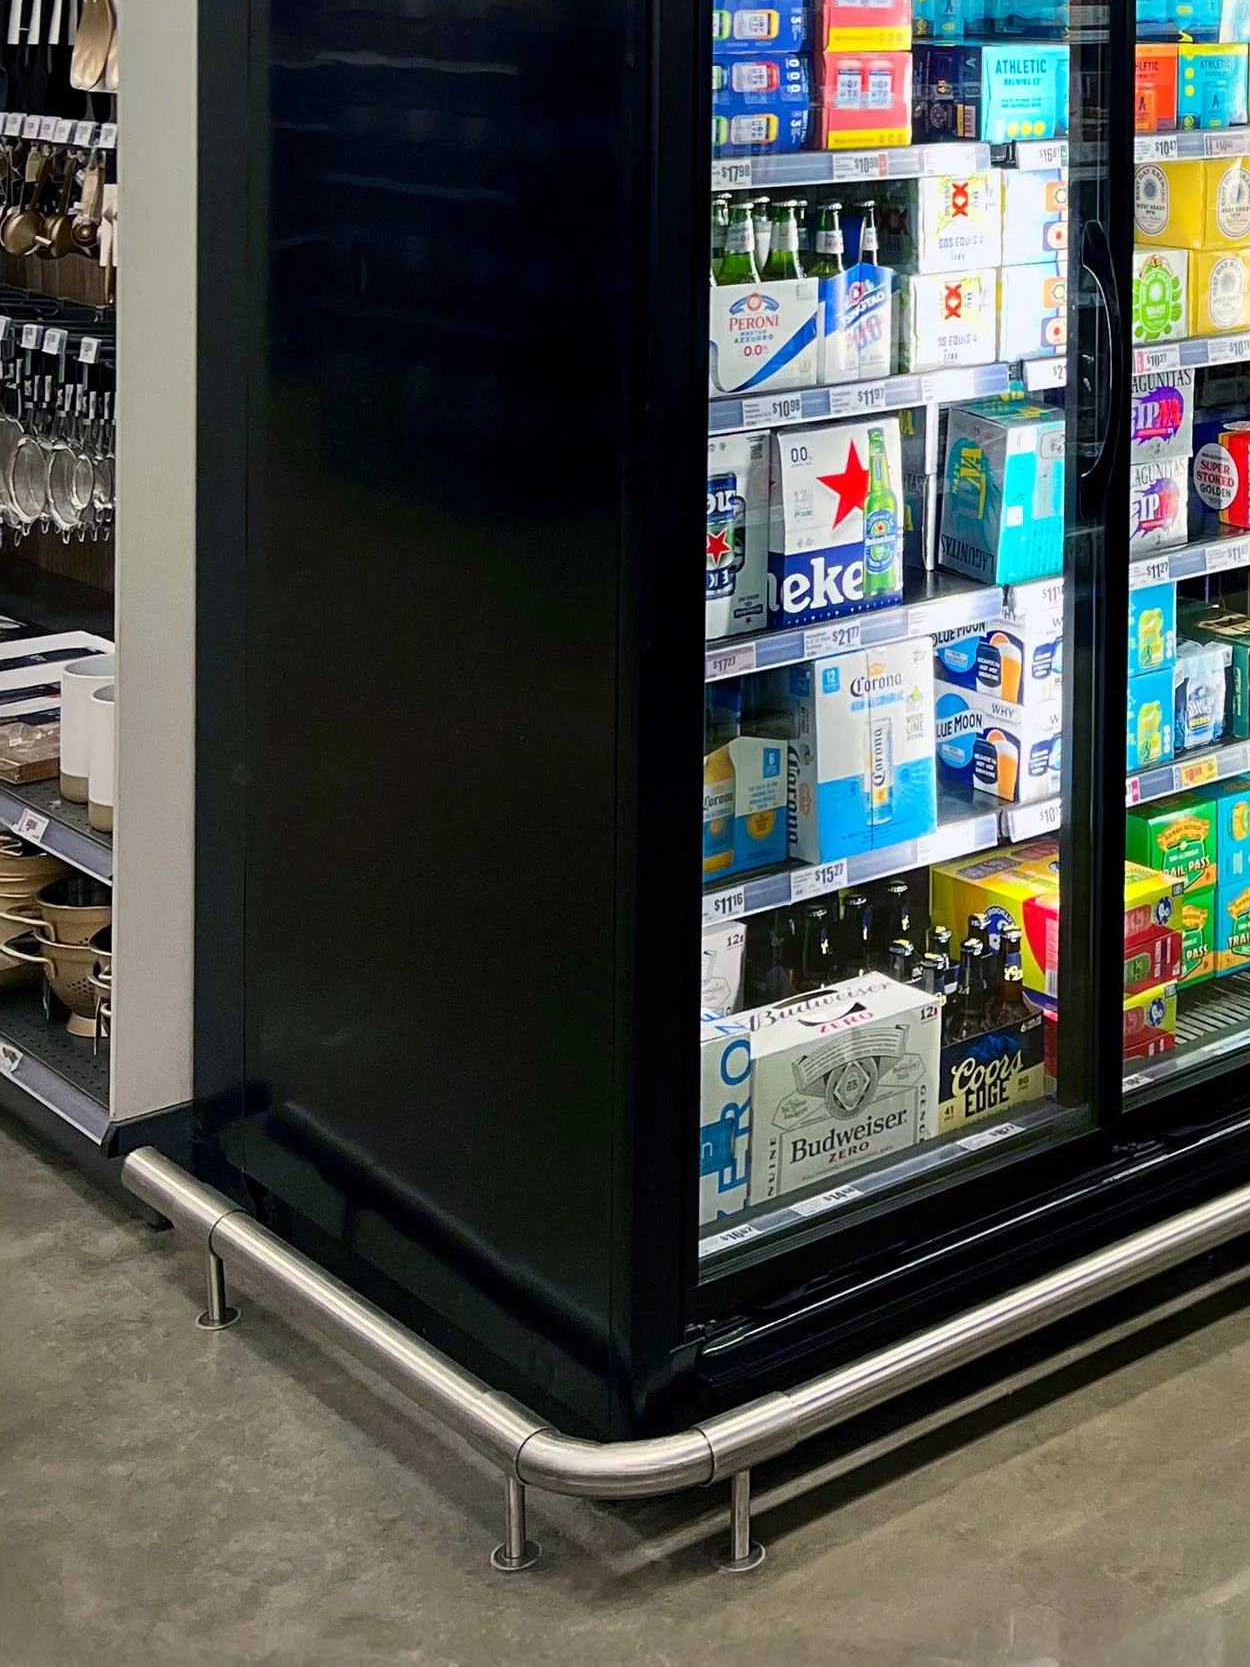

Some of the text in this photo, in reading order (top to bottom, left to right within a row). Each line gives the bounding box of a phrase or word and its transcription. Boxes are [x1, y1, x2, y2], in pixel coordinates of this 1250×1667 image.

[995, 60, 1047, 74] ATHLETIC
[1200, 59, 1232, 70] ATHLETIC
[729, 315, 779, 331] PERONI
[772, 399, 800, 418] $1098
[1200, 460, 1230, 474] SUPER
[1196, 471, 1234, 487] STOKED
[1200, 485, 1232, 499] GOLDEN
[940, 534, 996, 574] LAGUNITAS
[825, 669, 836, 683] 12
[850, 674, 902, 698] Corona
[992, 704, 1015, 719] WHY
[954, 714, 983, 734] MOON
[873, 728, 885, 787] Corona
[1188, 855, 1210, 870] PASS
[815, 864, 844, 884] $1527
[714, 893, 743, 913] $1116
[1186, 943, 1208, 959] PASS
[750, 981, 892, 1032] Budweiser
[819, 1011, 874, 1034] ZERO
[951, 1049, 1024, 1095] Coors
[964, 1082, 1010, 1118] EDGE
[789, 1109, 908, 1164] Budweiser
[828, 1141, 870, 1163] ZERO
